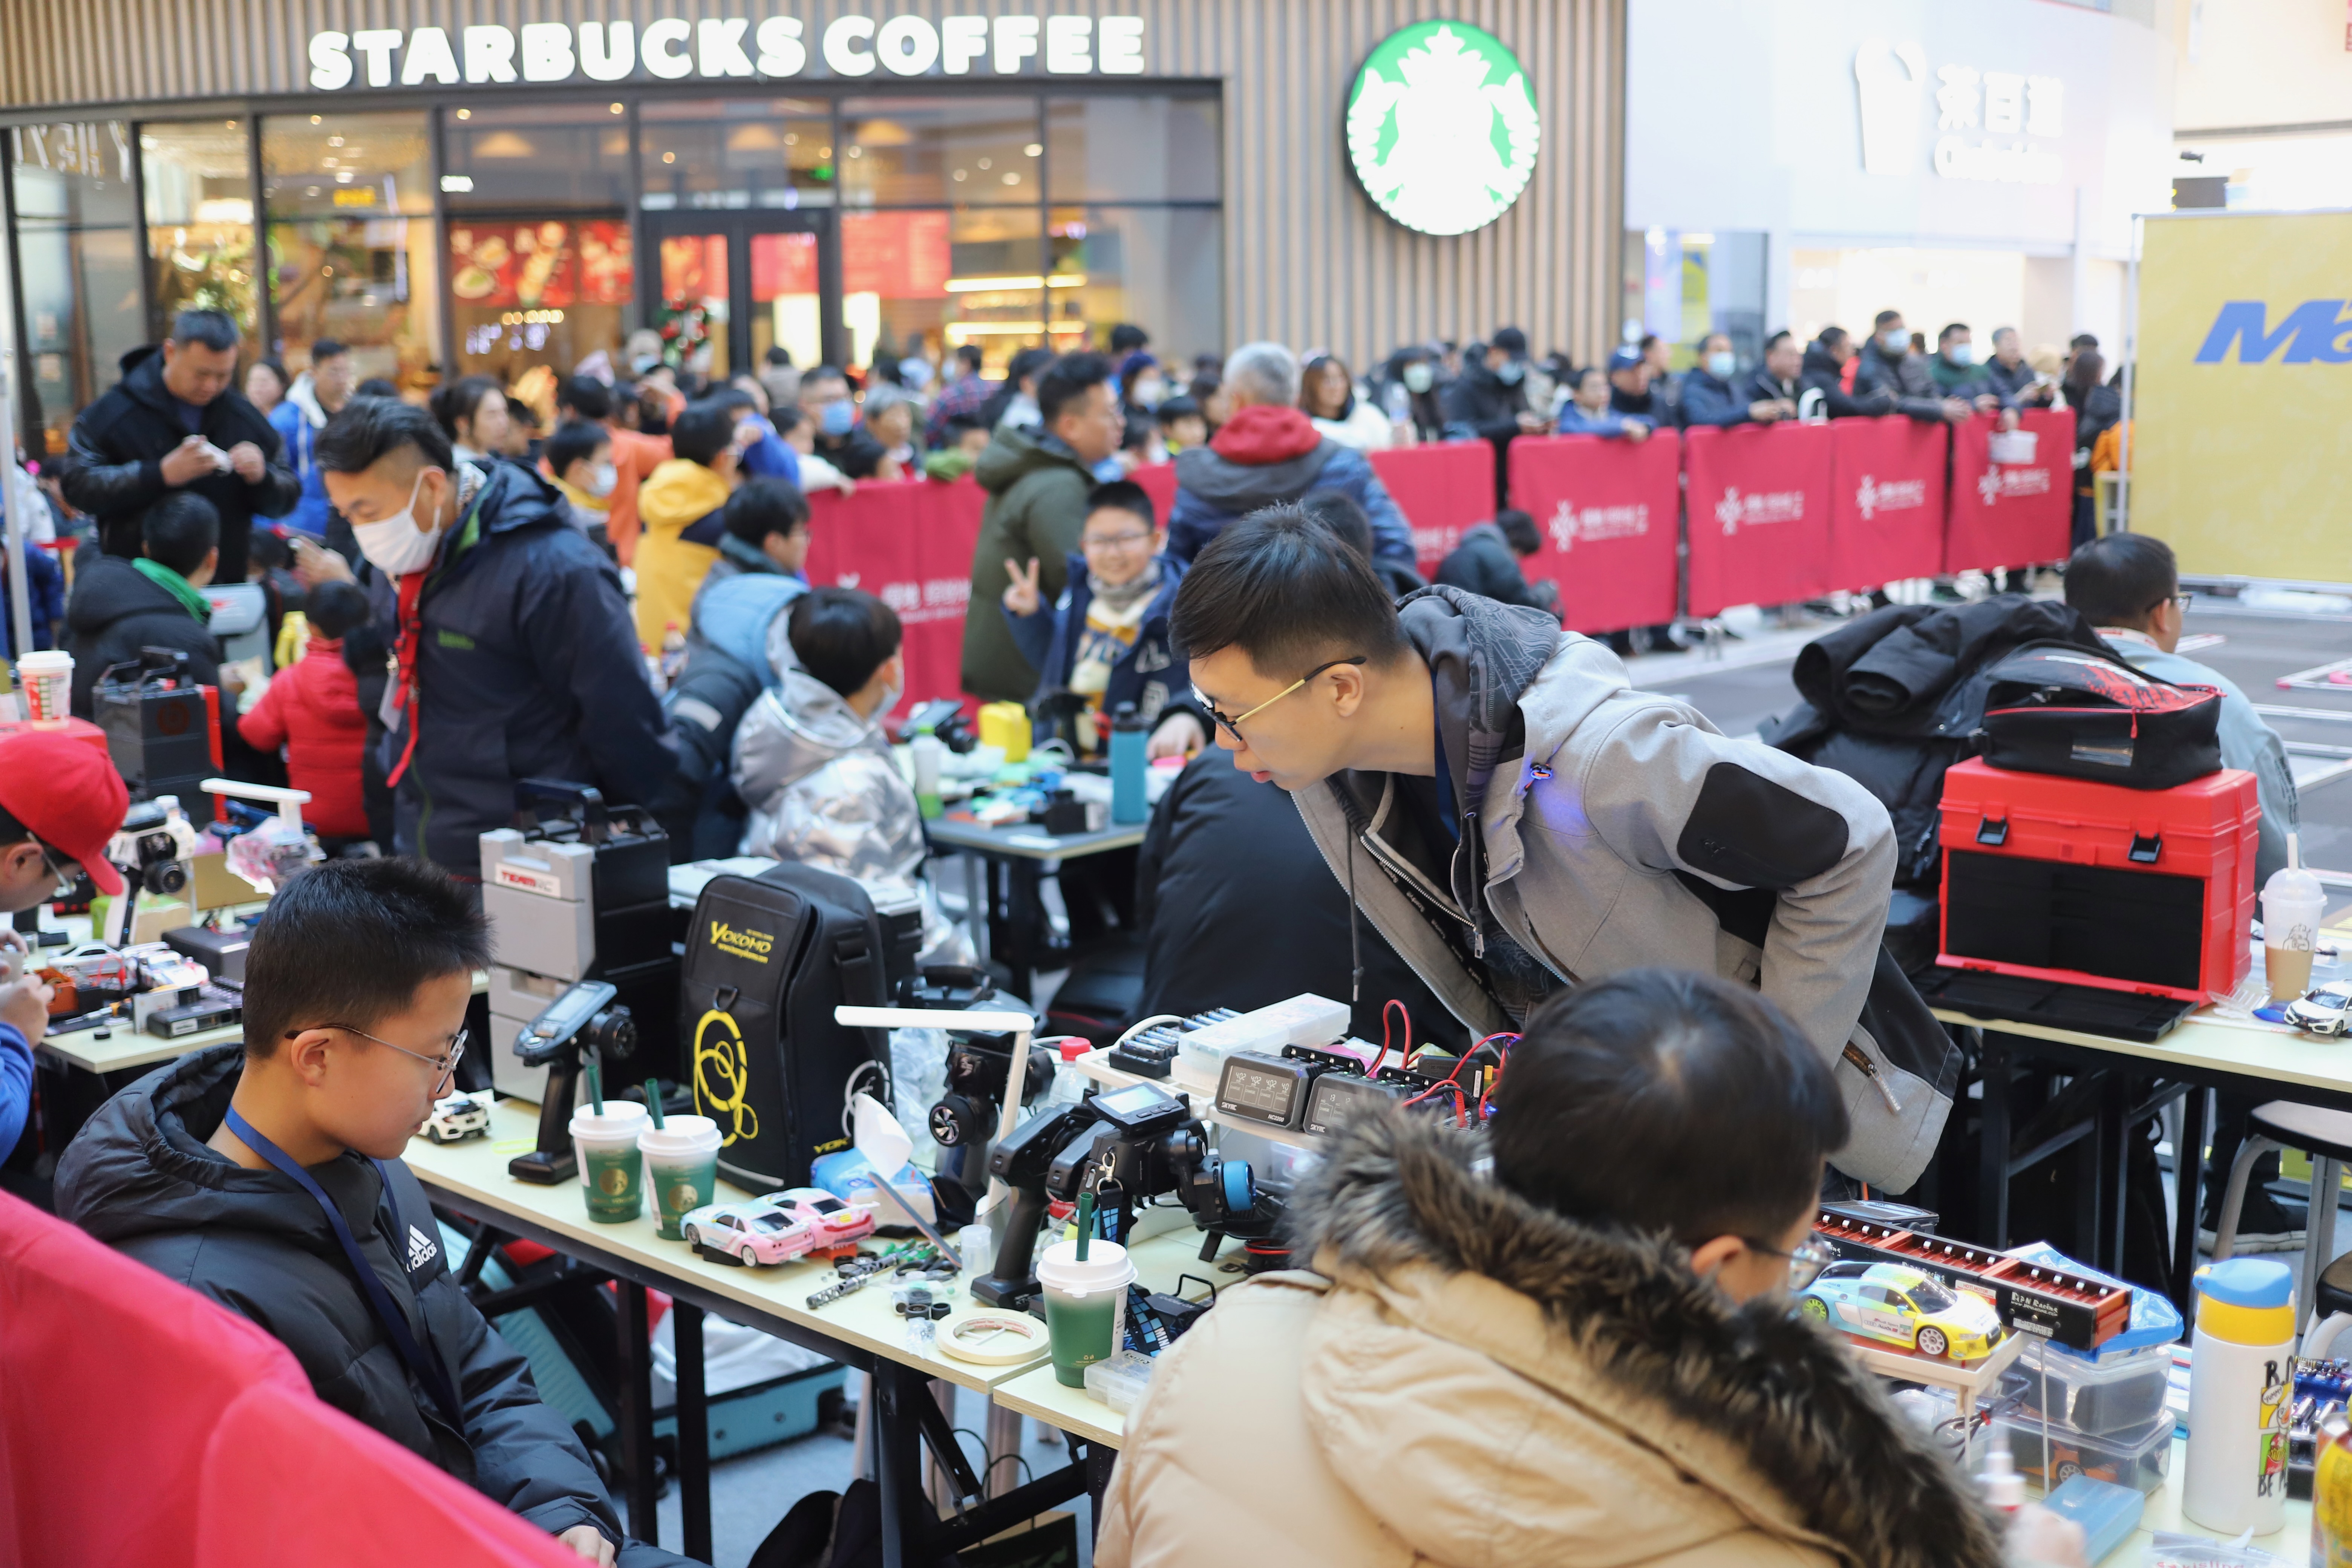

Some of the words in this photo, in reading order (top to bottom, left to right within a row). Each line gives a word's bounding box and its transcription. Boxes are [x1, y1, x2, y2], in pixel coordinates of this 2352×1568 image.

[308, 16, 806, 90] STARBUCKS
[822, 15, 1144, 76] COFFEE
[710, 920, 772, 953] YOKOMO
[1221, 1102, 1237, 1110] SKYRC
[1268, 1114, 1285, 1122] NC2200
[1310, 1124, 1326, 1133] SKYRC
